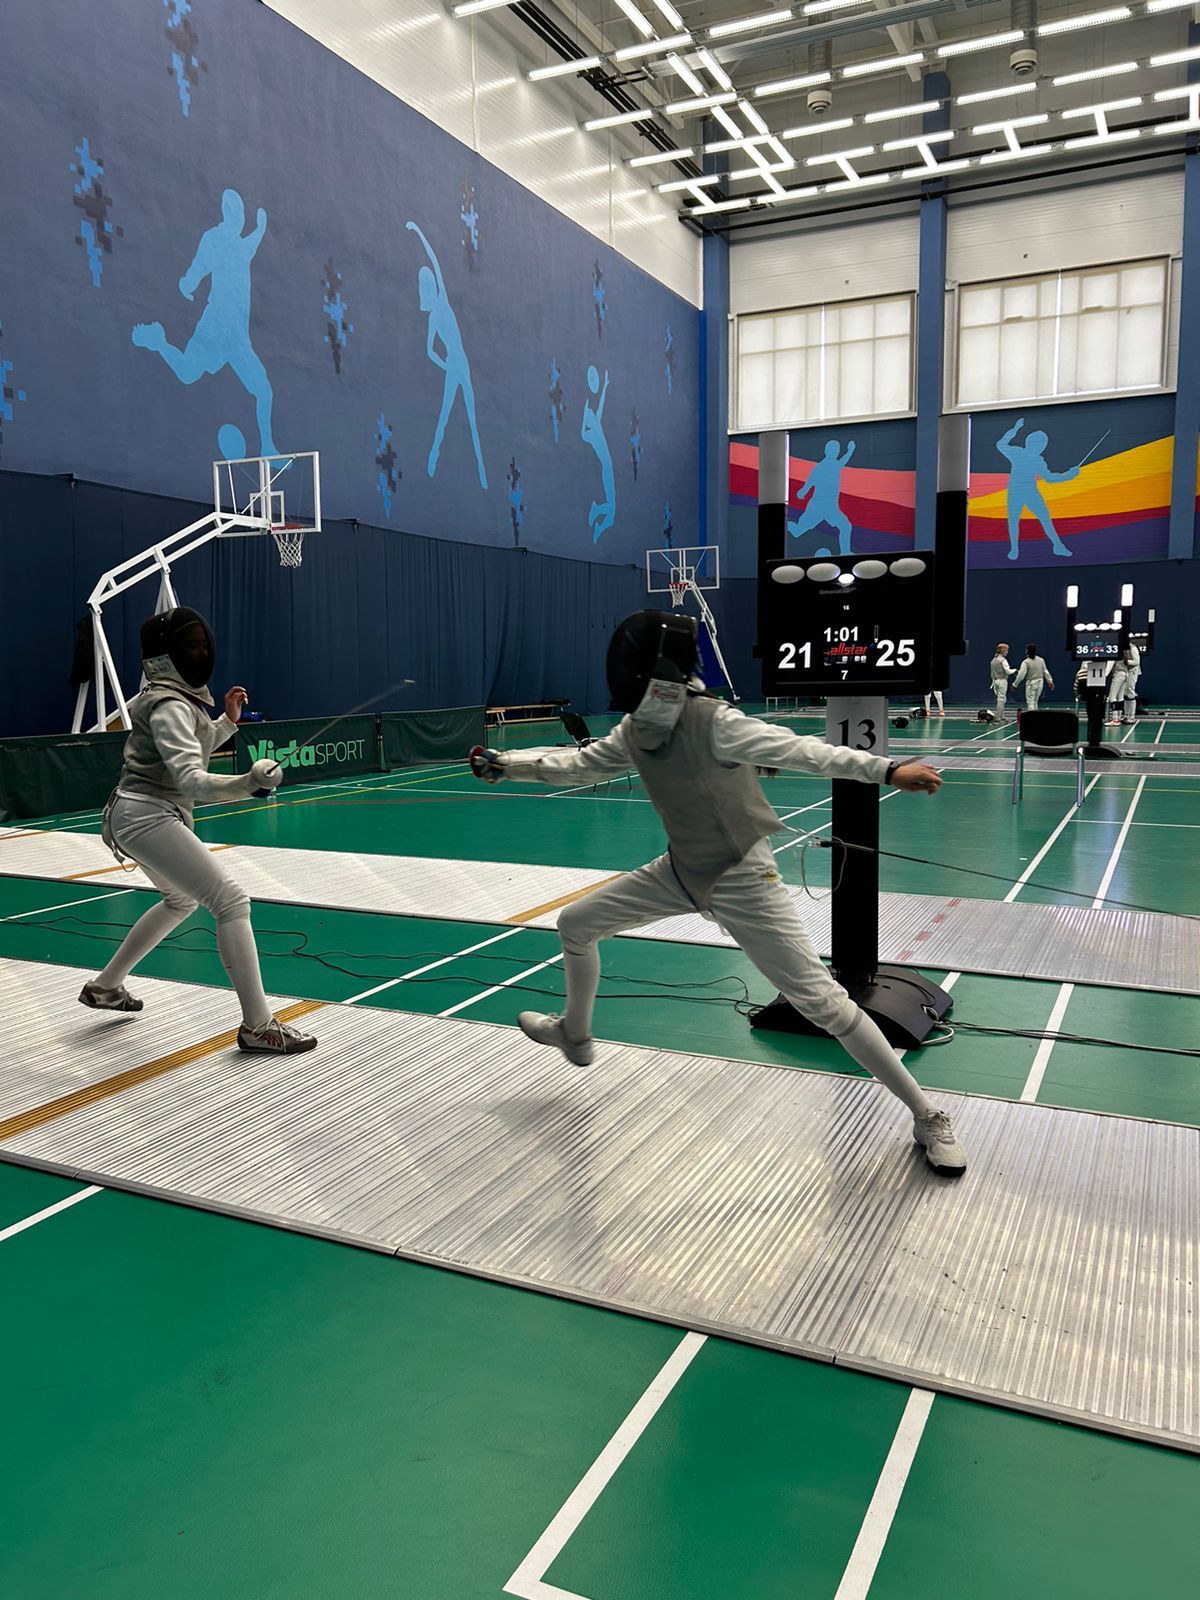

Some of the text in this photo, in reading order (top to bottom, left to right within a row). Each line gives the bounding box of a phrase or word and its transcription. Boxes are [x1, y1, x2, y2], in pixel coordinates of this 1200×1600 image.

[823, 626, 858, 642] 1:01
[829, 643, 867, 655] allstar
[875, 639, 915, 667] 25
[1076, 646, 1089, 654] 36
[1106, 645, 1118, 653] 33
[778, 642, 811, 669] 21
[841, 670, 848, 680] 7
[1092, 668, 1103, 678] 11
[836, 719, 876, 750] 13
